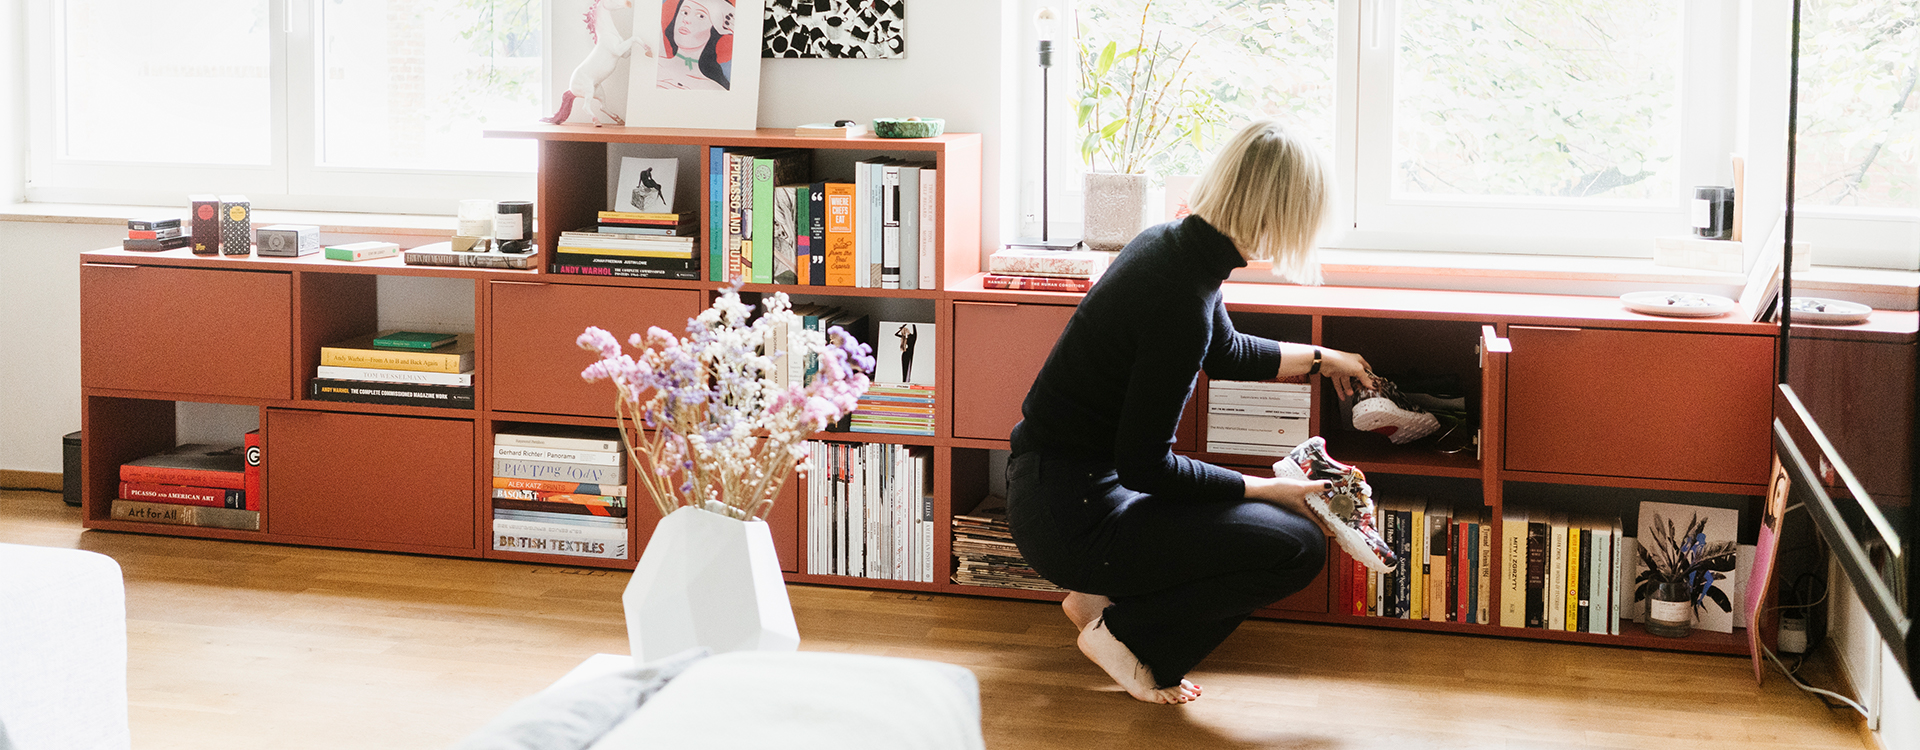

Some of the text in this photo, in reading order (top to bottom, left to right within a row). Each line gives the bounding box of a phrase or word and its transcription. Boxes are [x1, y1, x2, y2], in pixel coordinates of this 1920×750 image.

[831, 198, 849, 206] WHERE
[832, 206, 848, 215] CHEFS
[730, 164, 741, 272] PICASSO AND TRUTH
[561, 265, 612, 275] ANDY WARHOL
[380, 373, 427, 381] WESSELMANN
[547, 452, 576, 460] Panorama
[497, 490, 539, 500] BASQUIAT
[128, 508, 177, 520] Art for All
[500, 536, 605, 554] BRITISH TEXTILES
